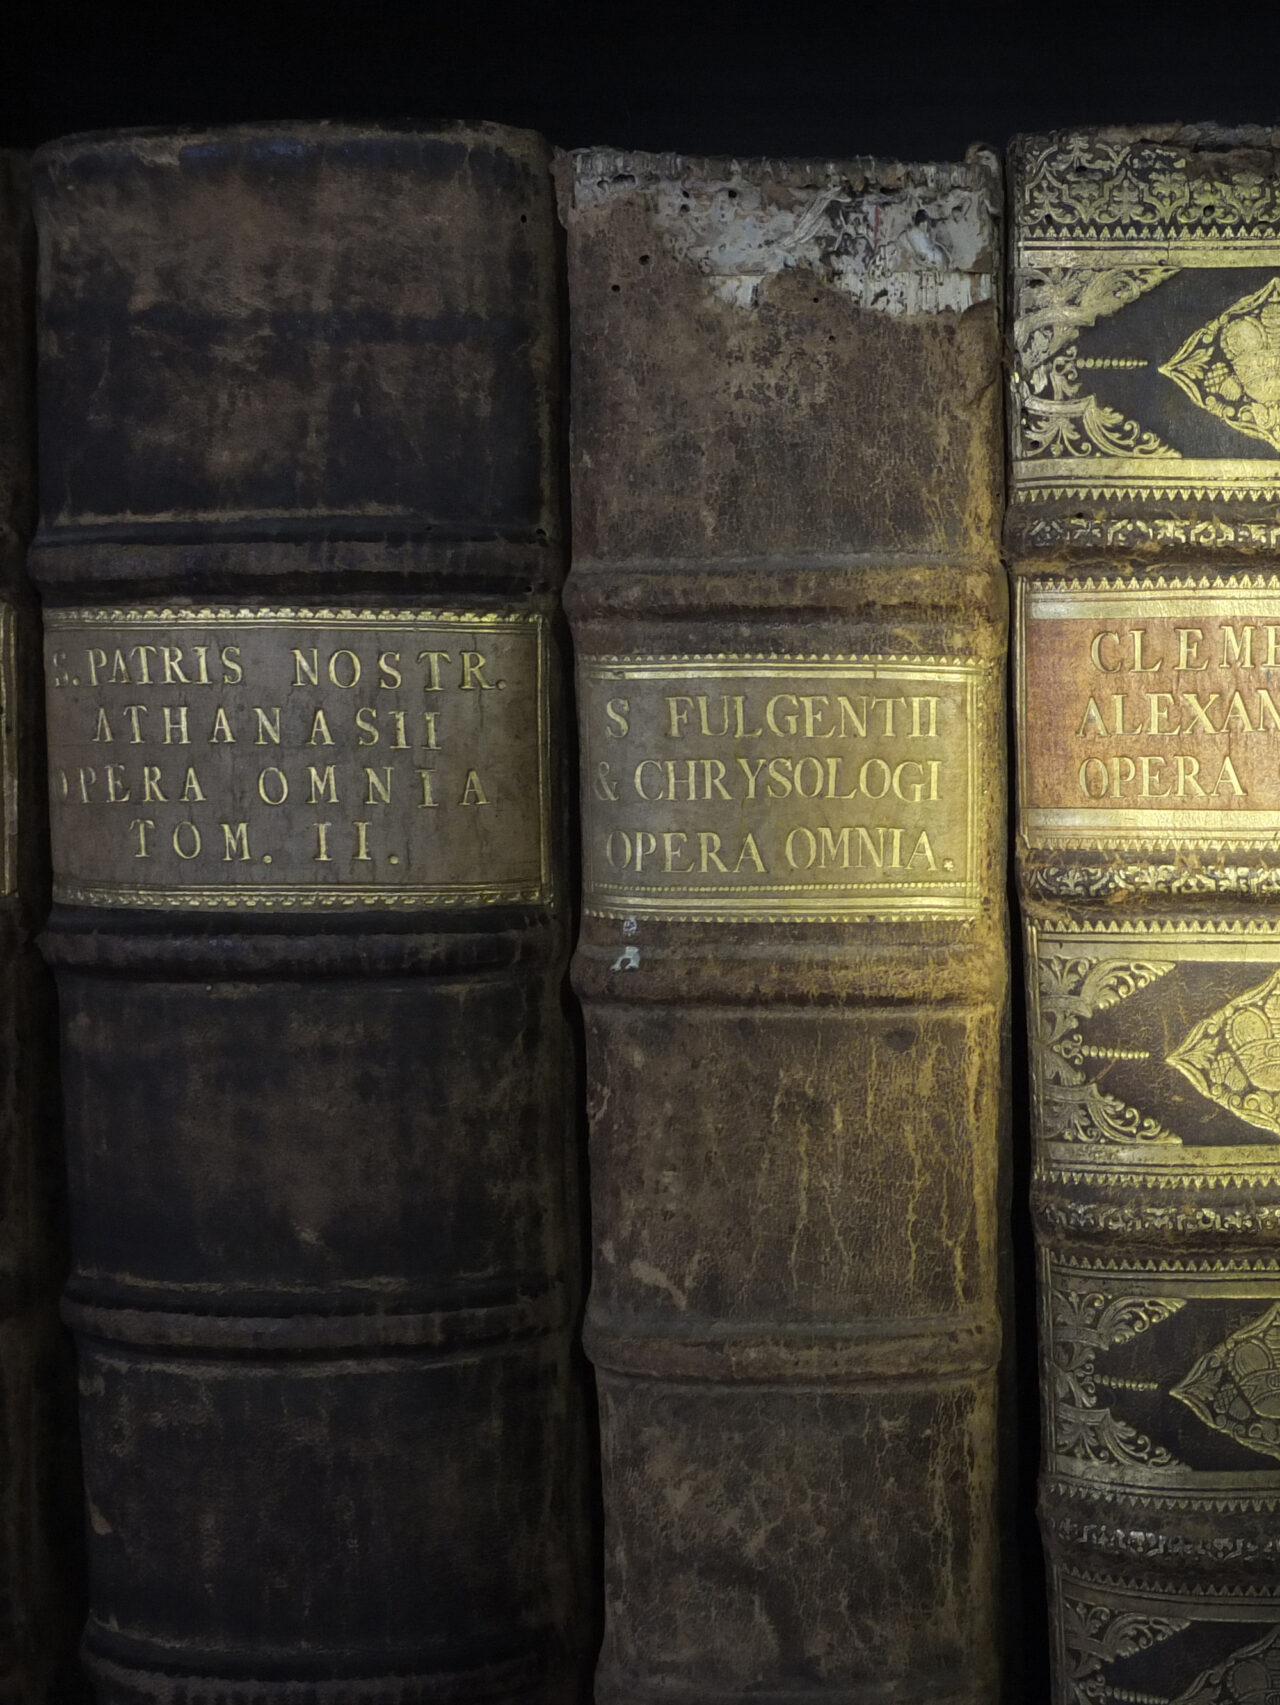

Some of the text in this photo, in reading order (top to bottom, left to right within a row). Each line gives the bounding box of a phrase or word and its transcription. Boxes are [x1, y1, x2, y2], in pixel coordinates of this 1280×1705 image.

[290, 649, 507, 691] NOSTR.
[91, 705, 442, 750] ATHANASII
[665, 695, 942, 738] FULGENTII
[258, 764, 491, 808] OMNIA
[634, 757, 944, 802] CHRYSOLOGI
[1079, 755, 1247, 799] OPERA
[130, 819, 400, 864] TOM. II.
[606, 826, 955, 873] OPERA OMNIA.
